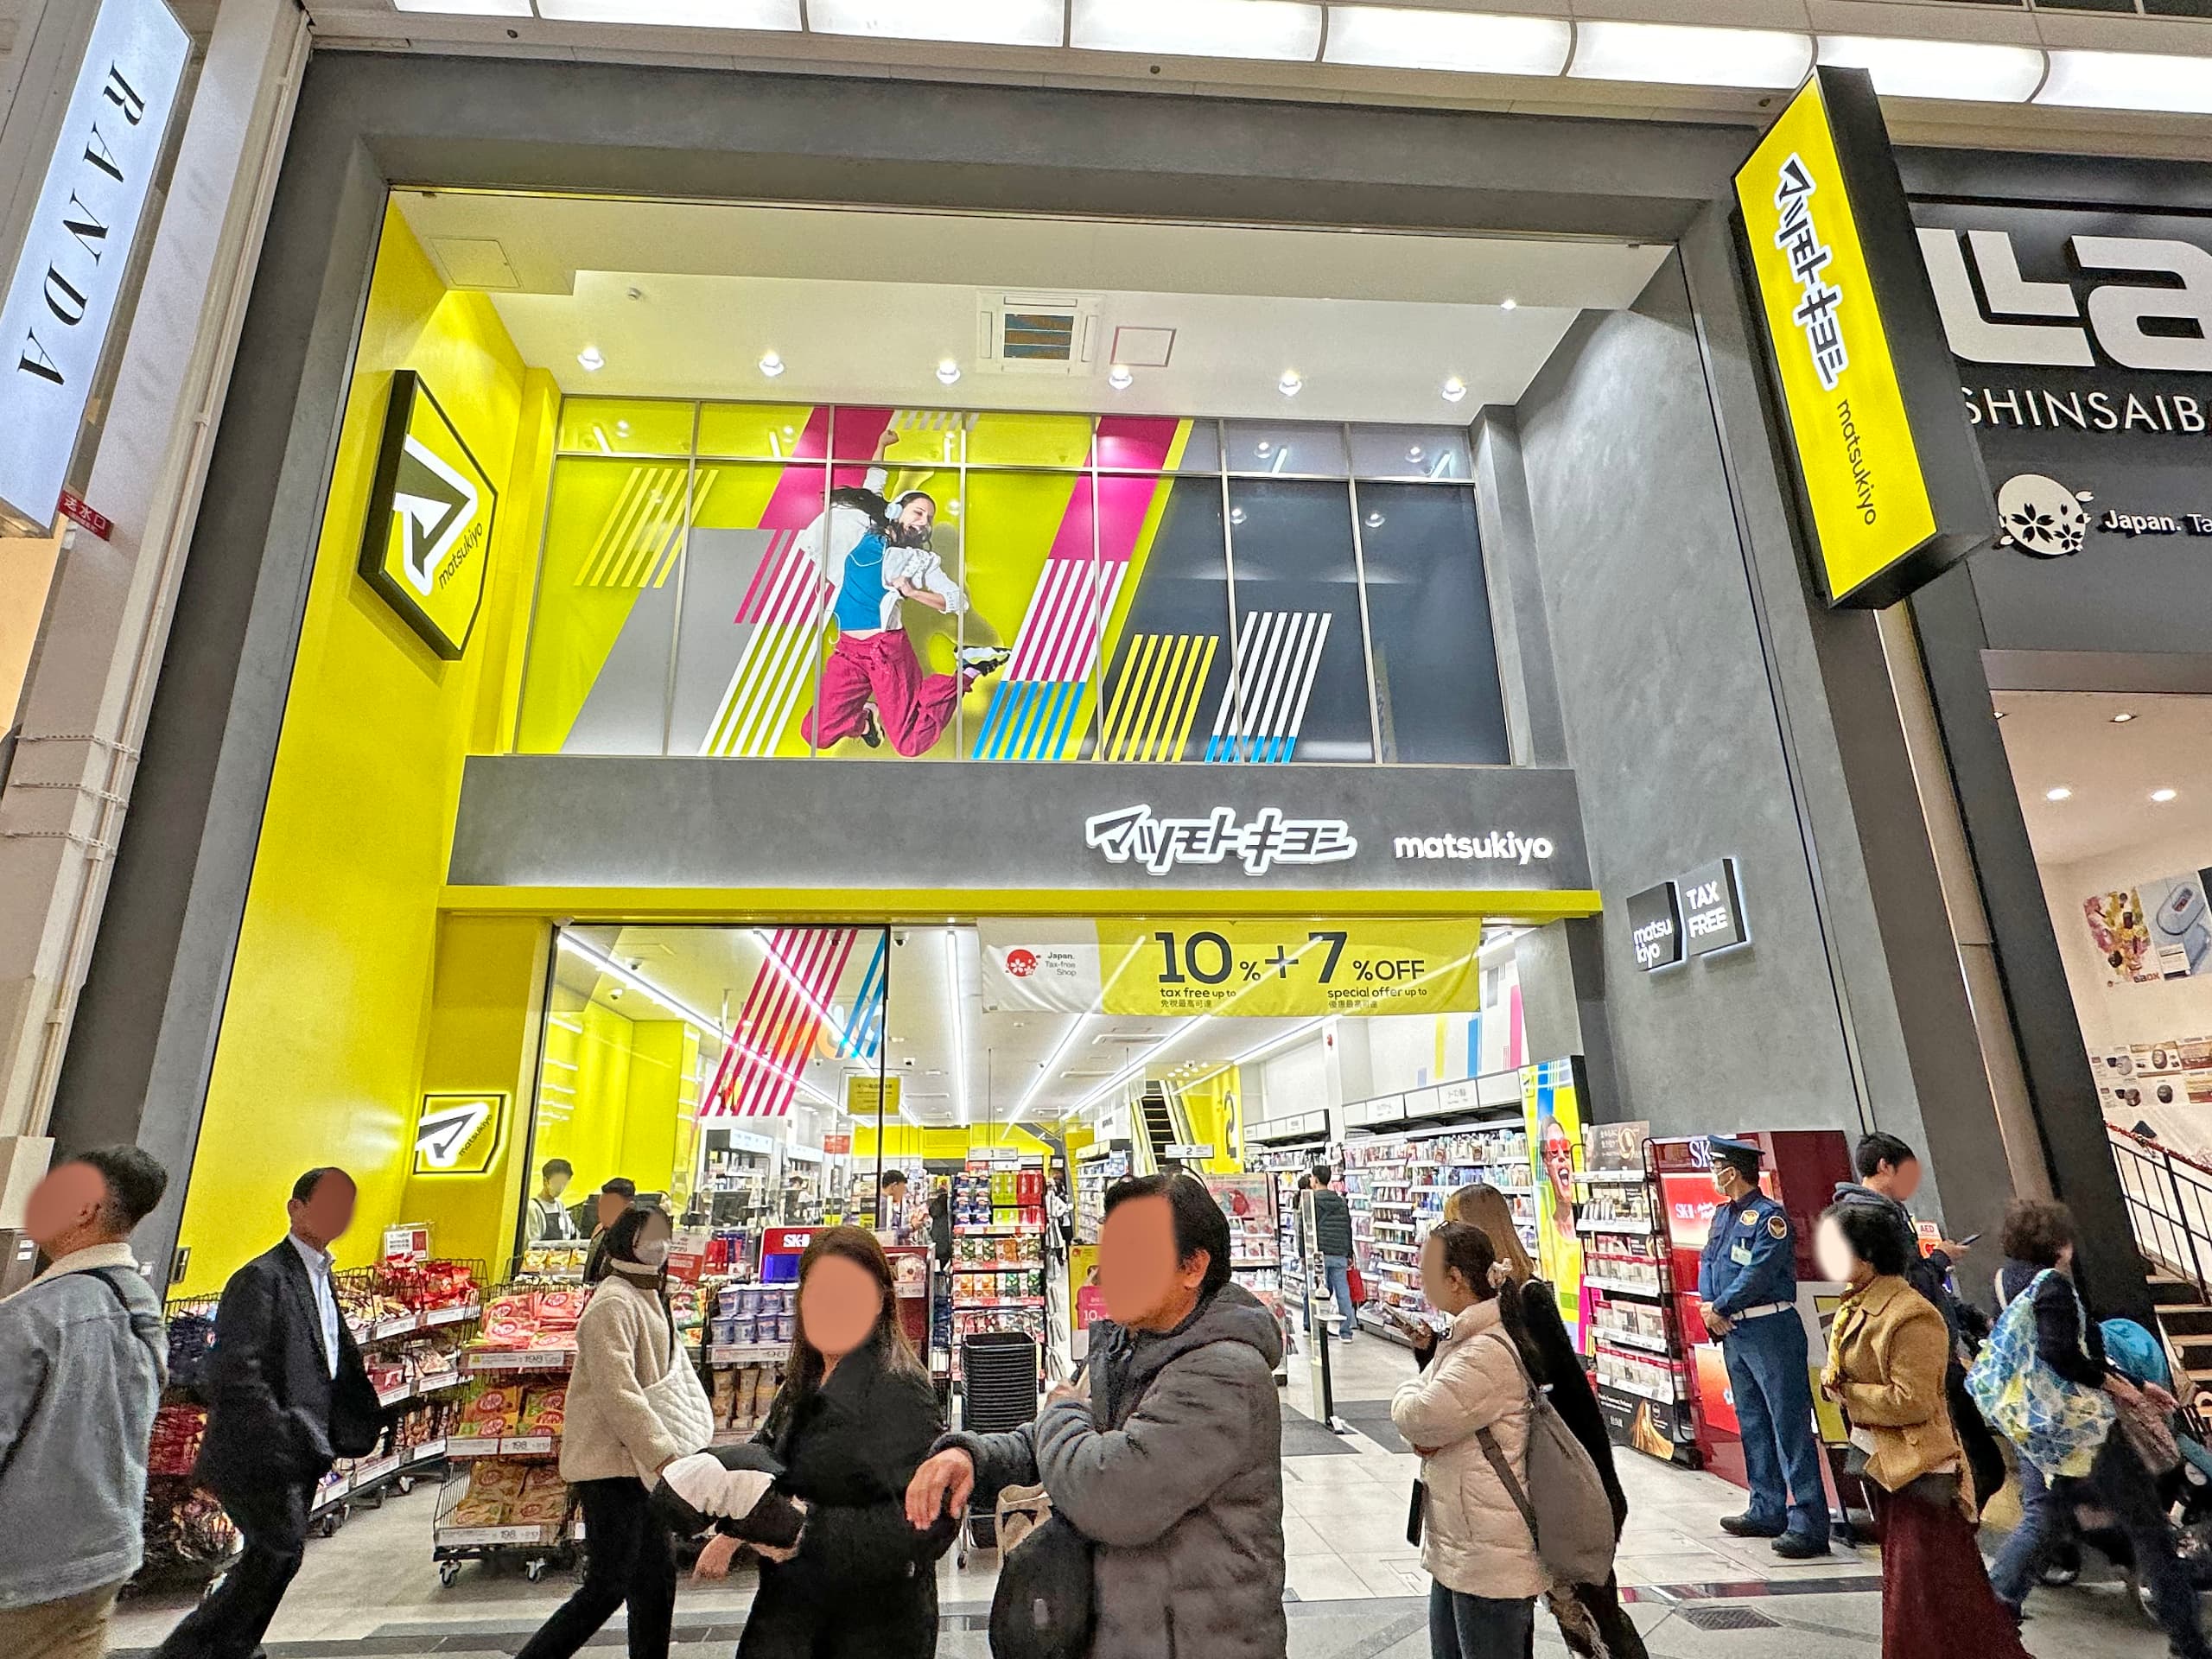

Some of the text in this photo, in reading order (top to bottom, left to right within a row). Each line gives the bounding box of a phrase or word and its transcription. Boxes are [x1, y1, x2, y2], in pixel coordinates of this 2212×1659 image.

[16, 60, 147, 386] RANDA
[1837, 398, 1875, 526] matsukiyo
[2105, 510, 2181, 533] Japan.
[439, 522, 484, 589] matsukiyo
[1395, 830, 1553, 865] matsukiyo
[1686, 880, 1720, 909] TAX
[1633, 919, 1673, 944] matsu
[1688, 906, 1728, 938] FREE
[1047, 952, 1075, 961] Japan.
[1636, 943, 1660, 968] kiyo
[1160, 988, 1180, 997] tax
[1184, 988, 1210, 998] free
[1327, 987, 1370, 1000] special
[1372, 987, 1403, 997] offer
[459, 1114, 493, 1156] matsukiyo
[1920, 1224, 1935, 1233] AED
